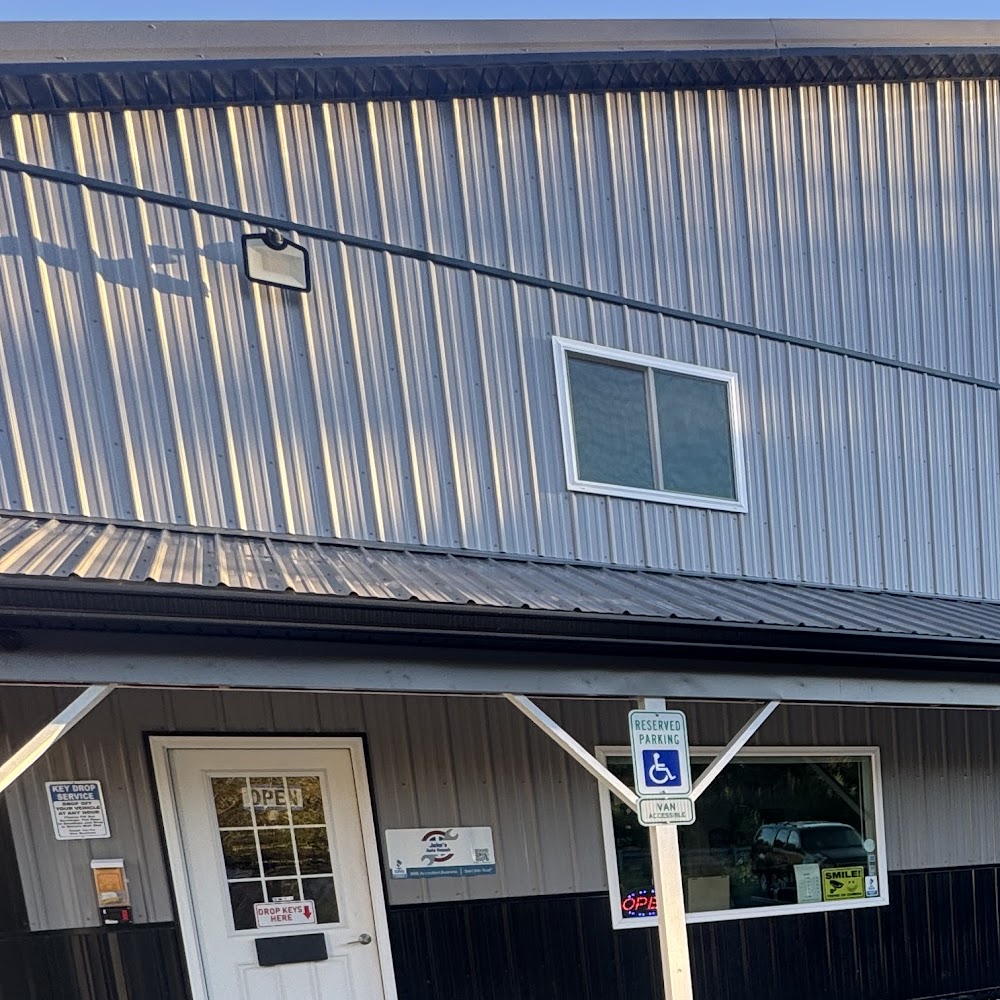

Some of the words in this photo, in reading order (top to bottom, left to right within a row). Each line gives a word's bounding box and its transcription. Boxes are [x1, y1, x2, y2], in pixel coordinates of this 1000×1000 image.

[635, 720, 681, 731] RESERVED
[639, 734, 680, 745] PARKING
[51, 785, 70, 793] KEY
[72, 784, 96, 792] DROP
[56, 792, 95, 800] SERVICE
[251, 789, 298, 805] OPEN
[656, 803, 676, 811] VAN
[825, 870, 861, 879] SMILE!
[622, 896, 657, 911] OPE
[257, 907, 281, 916] DROP
[282, 905, 303, 914] KEYS
[270, 913, 293, 922] HERE
